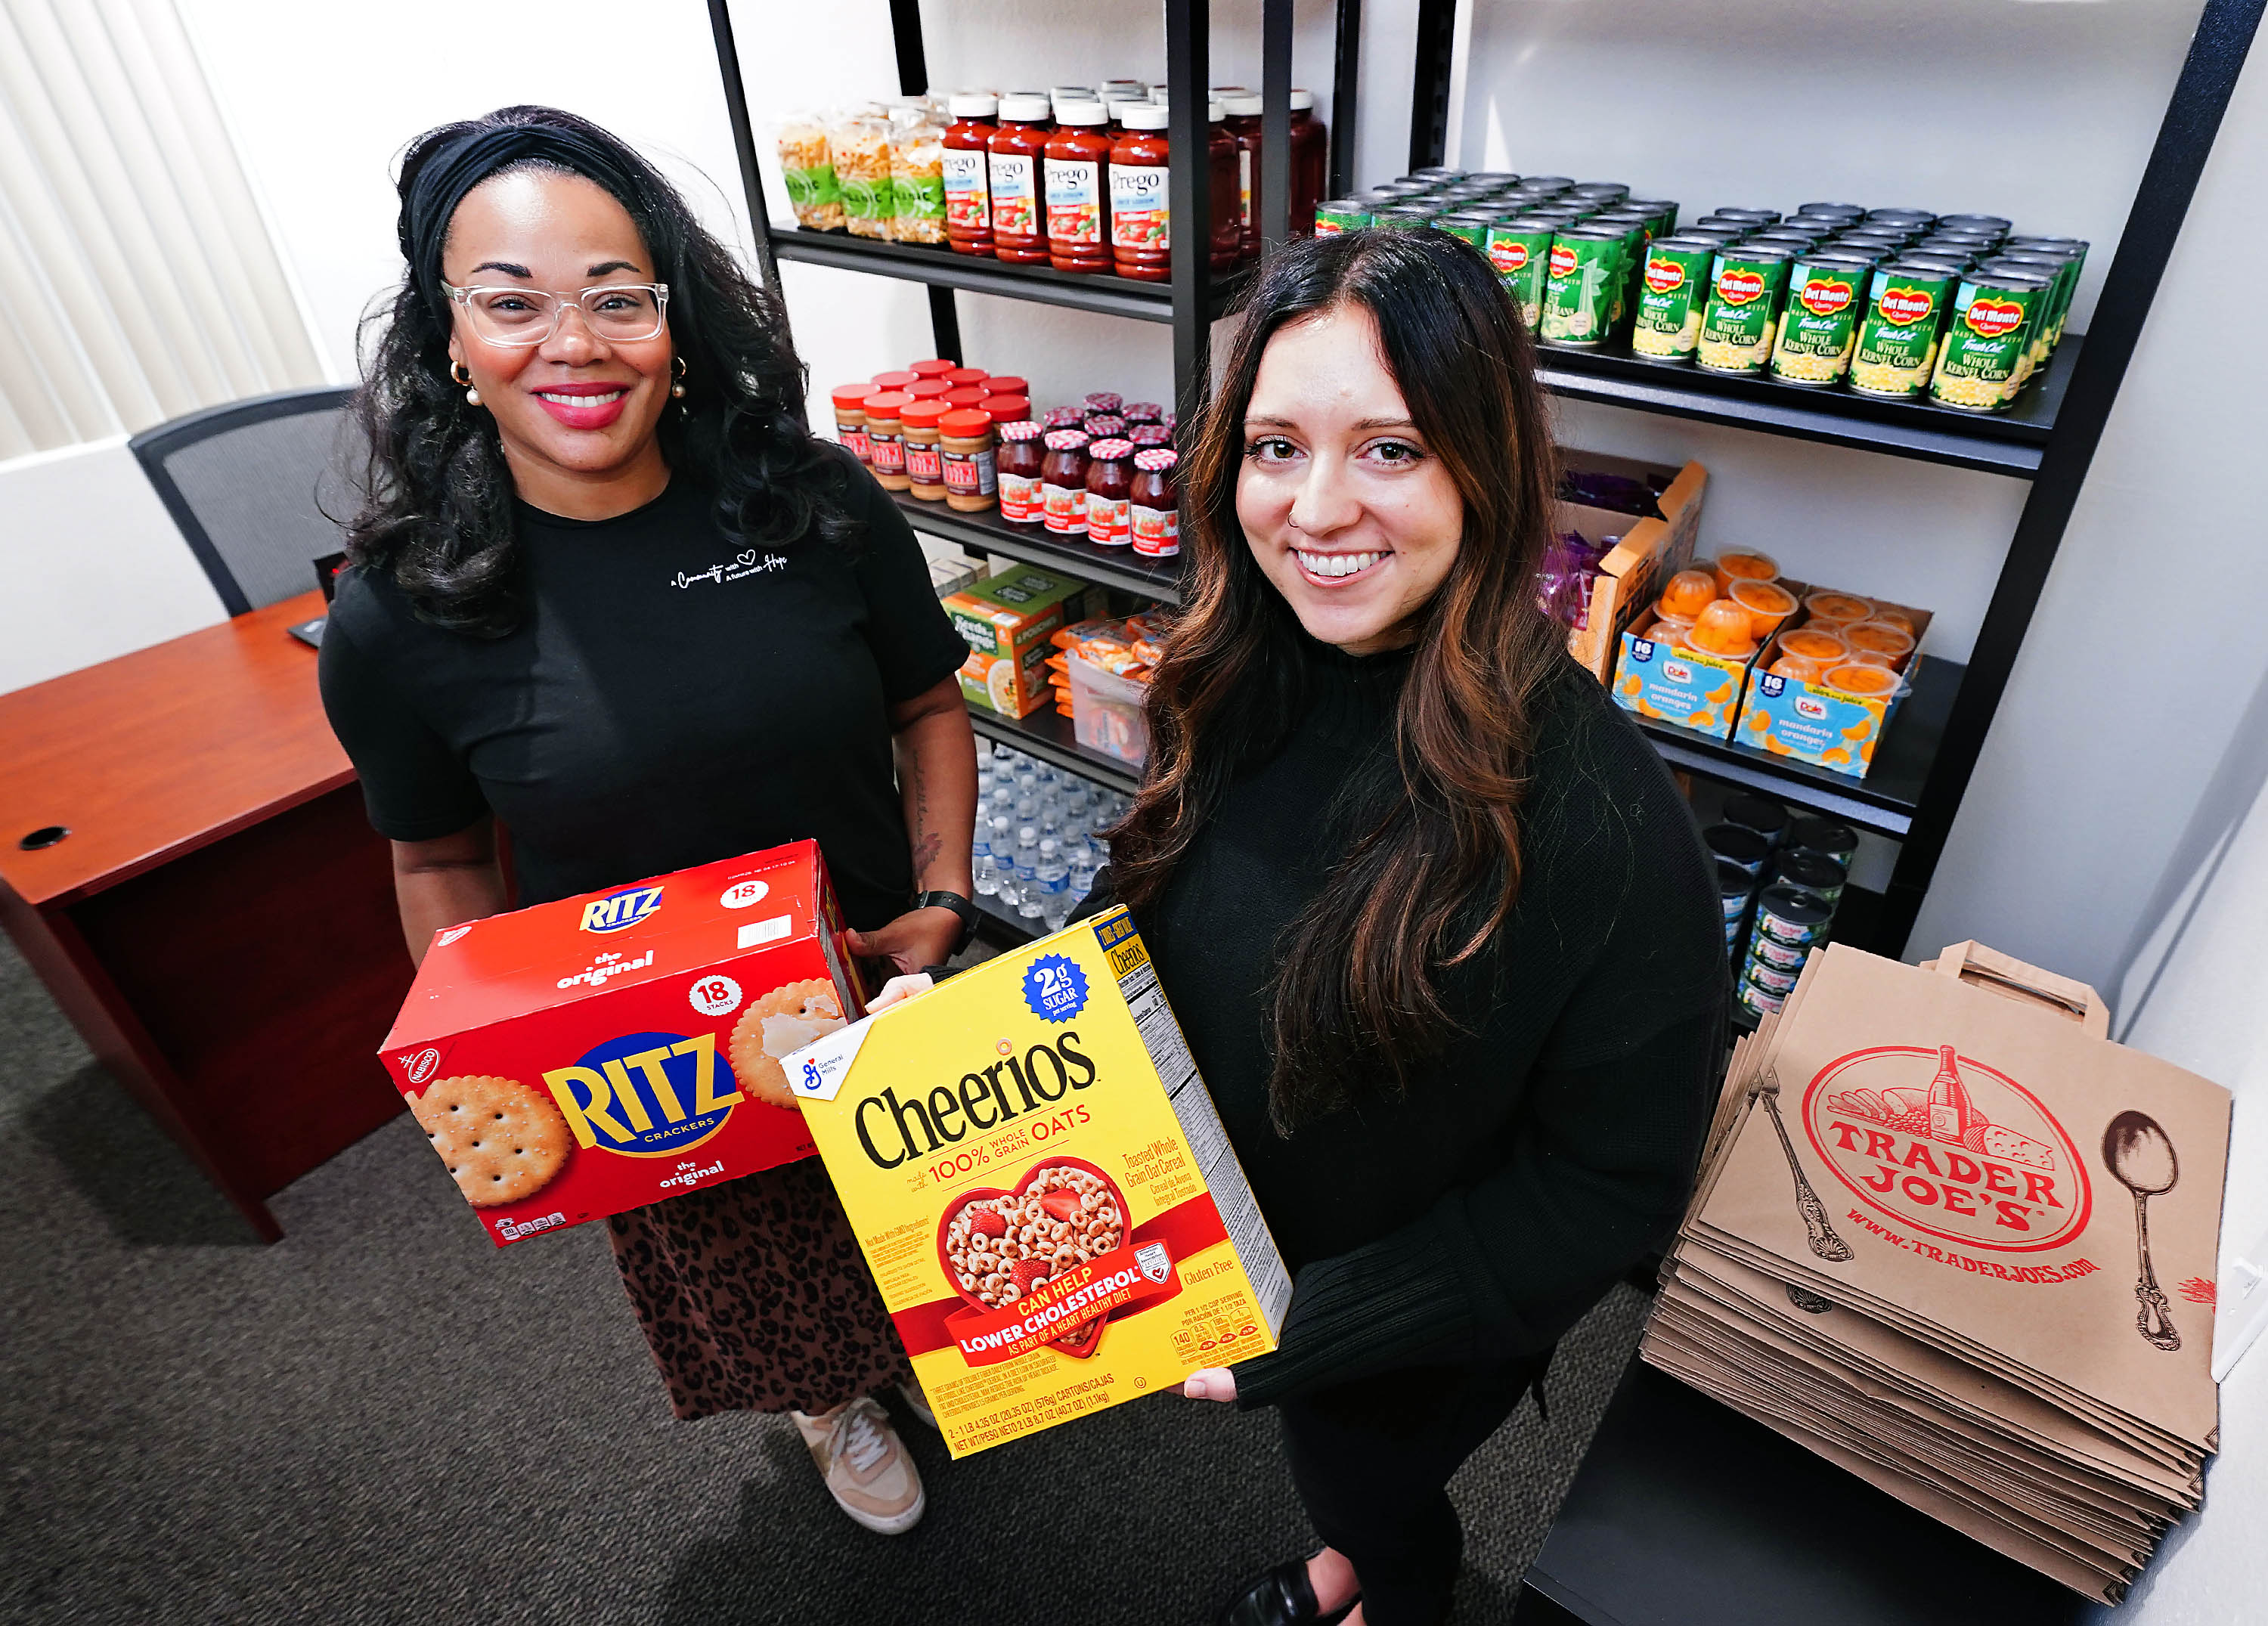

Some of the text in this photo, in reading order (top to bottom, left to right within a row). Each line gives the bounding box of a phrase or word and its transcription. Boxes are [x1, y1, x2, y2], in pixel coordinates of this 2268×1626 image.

[944, 158, 975, 177] rego
[1113, 171, 1159, 196] Prego
[1657, 269, 1681, 281] Monte
[1721, 278, 1760, 293] Del Monte
[1805, 287, 1849, 302] Del Monte
[1882, 296, 1929, 312] Del Monte
[1644, 308, 1668, 321] WHOLE
[1799, 317, 1839, 331] Fresh Cut
[1970, 308, 2020, 324] Del Monte
[1656, 321, 1680, 333] CORN
[1704, 328, 1757, 345] KERNEL CORN
[1716, 321, 1745, 333] WHOLE
[1876, 327, 1918, 340] Fresh Cut
[1784, 339, 1842, 356] KERNEL CORN
[1799, 331, 1831, 345] WHOLE
[1962, 339, 2007, 353] Fresh Cut
[1861, 348, 1920, 367] KERNEL CORN
[1876, 341, 1910, 355] WHOLE
[1946, 361, 2009, 379] KERNEL CORN
[1963, 353, 1998, 370] WHOLE
[749, 565, 763, 574] with
[763, 553, 787, 571] Hope
[678, 563, 739, 589] Community with
[1635, 641, 1651, 655] 16
[1668, 666, 1687, 678] Dole
[1765, 676, 1783, 689] 16
[1650, 683, 1697, 702] mandarin
[1651, 693, 1691, 710] oranges
[1801, 702, 1822, 714] Dole
[1779, 720, 1833, 738] mandarin
[1781, 729, 1824, 745] oranges
[732, 885, 755, 900] 18
[579, 886, 665, 931] RITZ
[595, 952, 622, 964] the
[1111, 943, 1145, 974] Cheerios
[557, 950, 653, 989] original
[1034, 964, 1072, 998] 2g
[697, 981, 729, 1004] 18
[1043, 987, 1078, 1010] SUGAR
[706, 999, 733, 1010] STACKS
[1060, 1002, 1077, 1012] serving
[412, 1051, 435, 1080] NABISCO
[819, 1055, 843, 1068] General
[822, 1066, 836, 1075] Mills
[543, 1032, 745, 1149] RITZ
[854, 1030, 1097, 1169] Cheerios
[644, 1118, 714, 1143] CRACKERS
[1031, 1104, 1091, 1140] OATS
[989, 1129, 1026, 1148] WHOLE
[995, 1138, 1030, 1157] GRAIN
[1122, 1137, 1178, 1169] Toasted Whole
[677, 1162, 696, 1171] the
[929, 1145, 990, 1182] 100%
[1125, 1152, 1185, 1188] Grain Oat Cereal
[1829, 1120, 2063, 1209] TRADER
[660, 1160, 724, 1188] original
[907, 1171, 926, 1185] made
[1150, 1173, 1191, 1194] Cereal de Avena
[912, 1182, 928, 1193] with
[1154, 1183, 1197, 1206] Integral Tostado
[1860, 1166, 2031, 1231] JOE'S
[1184, 1259, 1234, 1285] Gluten Free
[1018, 1267, 1092, 1316] CAN HELP
[960, 1268, 1141, 1353] LOWER CHOLESTEROL
[1185, 1309, 1195, 1317] PER
[1208, 1299, 1219, 1309] CUP
[1219, 1290, 1243, 1305] SERVING
[1193, 1310, 1211, 1323] RACIÓN
[1233, 1298, 1247, 1308] TAZA
[1007, 1288, 1132, 1356] AS PART OF A HEART HEALTHY DIET
[1173, 1332, 1190, 1346] 140
[949, 1373, 1114, 1439] 2 1 LB 4.35 OZ (20.35 OZ) (576g) CARTONS/CAJAS
[954, 1391, 1110, 1452] NET WT/PESO NETO 2 LB 8.7 OZ (40.7 OZ) (1.1kg)
